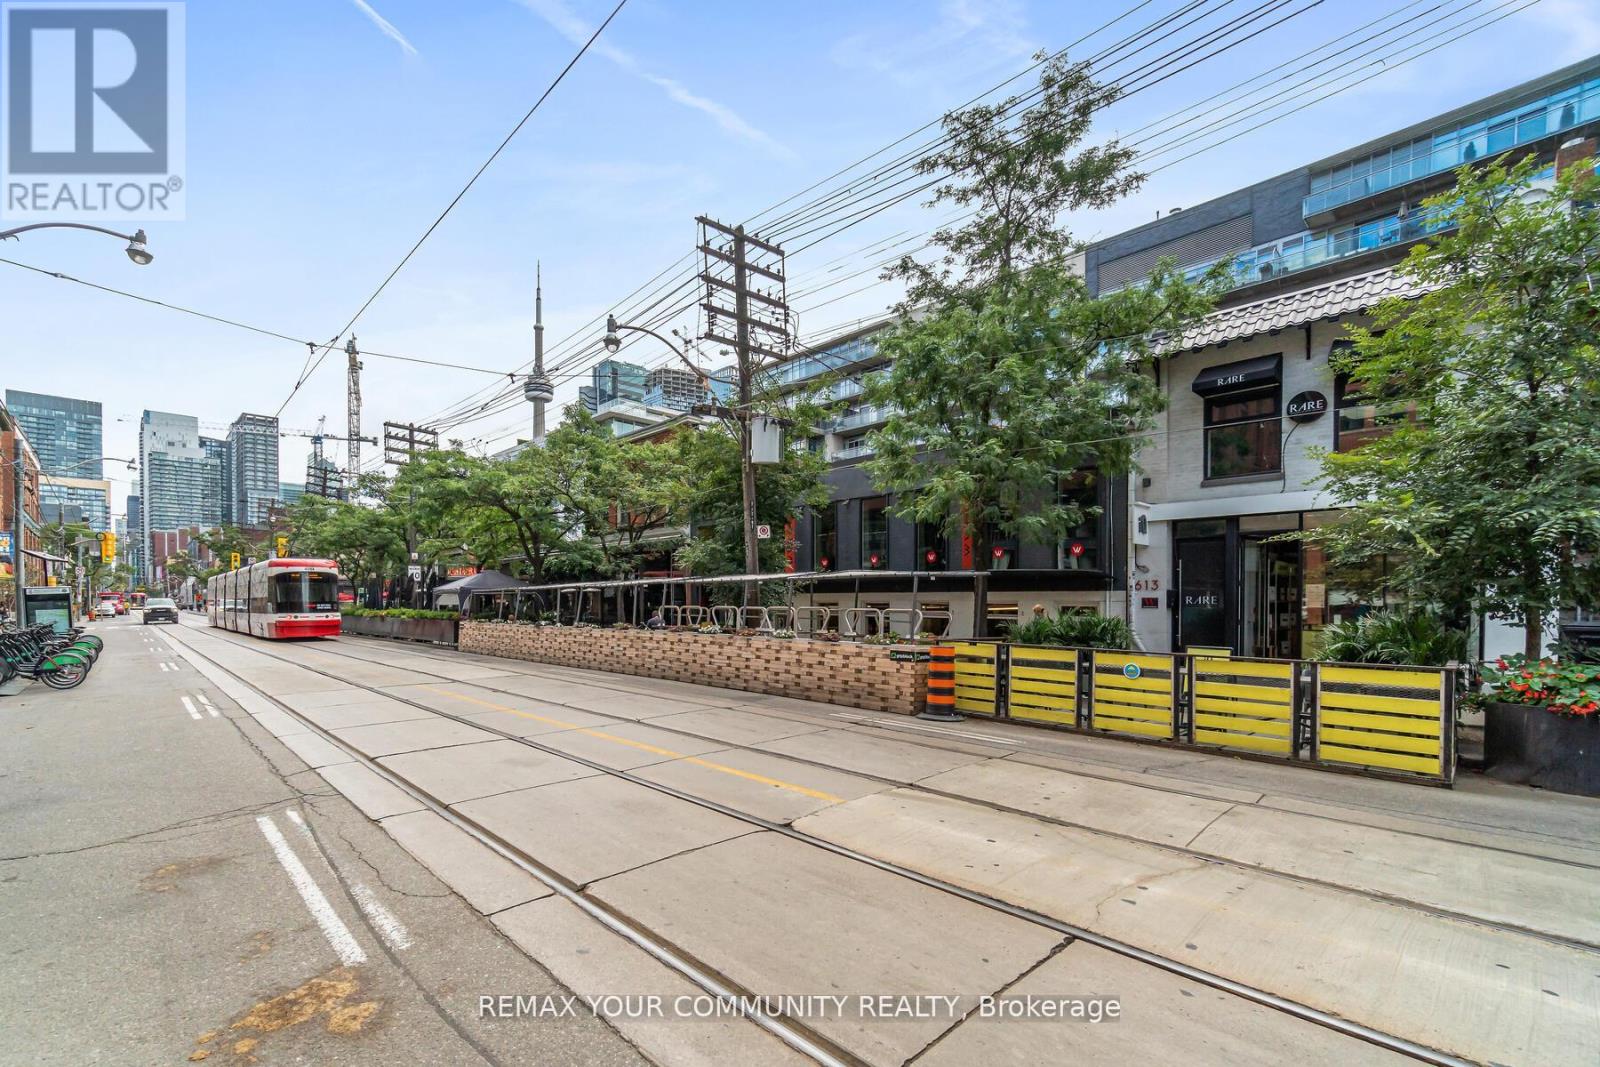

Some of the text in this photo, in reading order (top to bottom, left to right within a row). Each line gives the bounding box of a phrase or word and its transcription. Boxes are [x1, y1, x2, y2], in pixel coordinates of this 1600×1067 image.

[1217, 373, 1246, 386] RARE
[1289, 400, 1324, 413] RARE
[1135, 580, 1159, 591] 613
[1185, 595, 1218, 605] RARE
